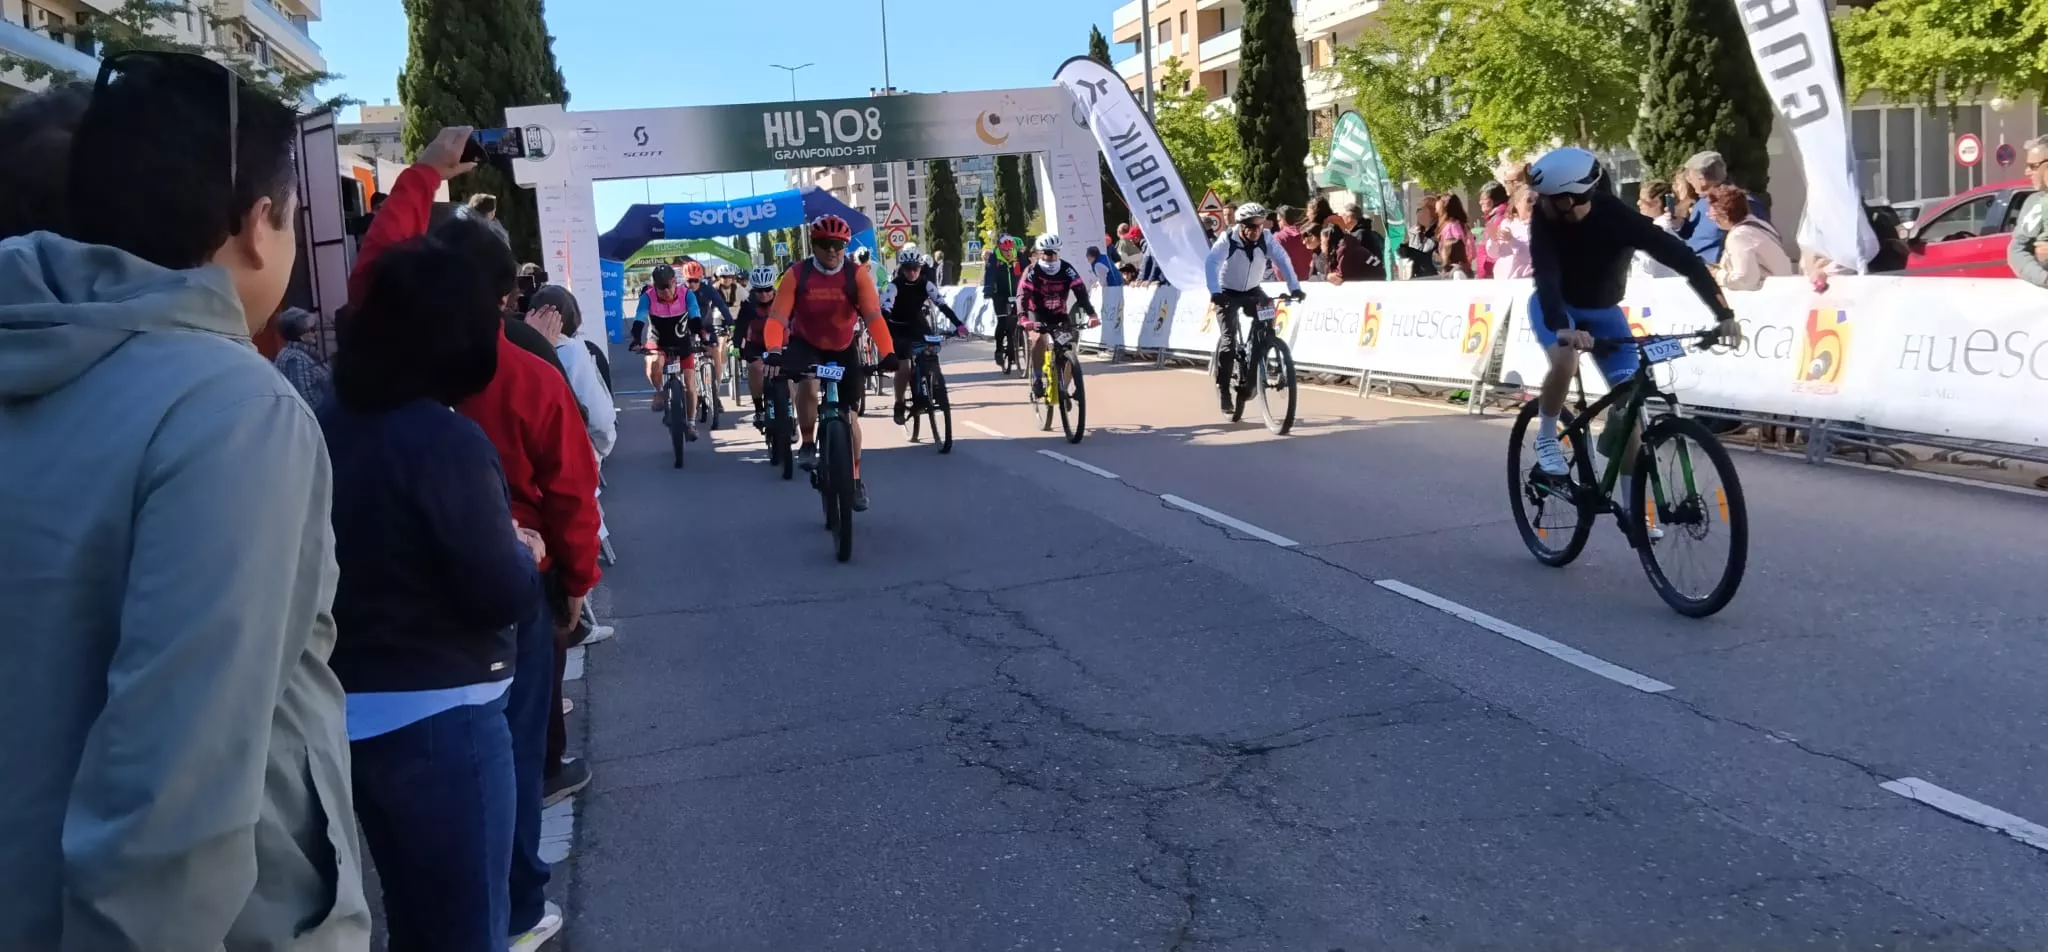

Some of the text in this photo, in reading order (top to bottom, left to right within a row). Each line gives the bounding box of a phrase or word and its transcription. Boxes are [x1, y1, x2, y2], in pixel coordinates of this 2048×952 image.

[1016, 113, 1058, 126] VICKY
[1109, 121, 1180, 225] GOBIK
[1648, 342, 1680, 356] 1076
